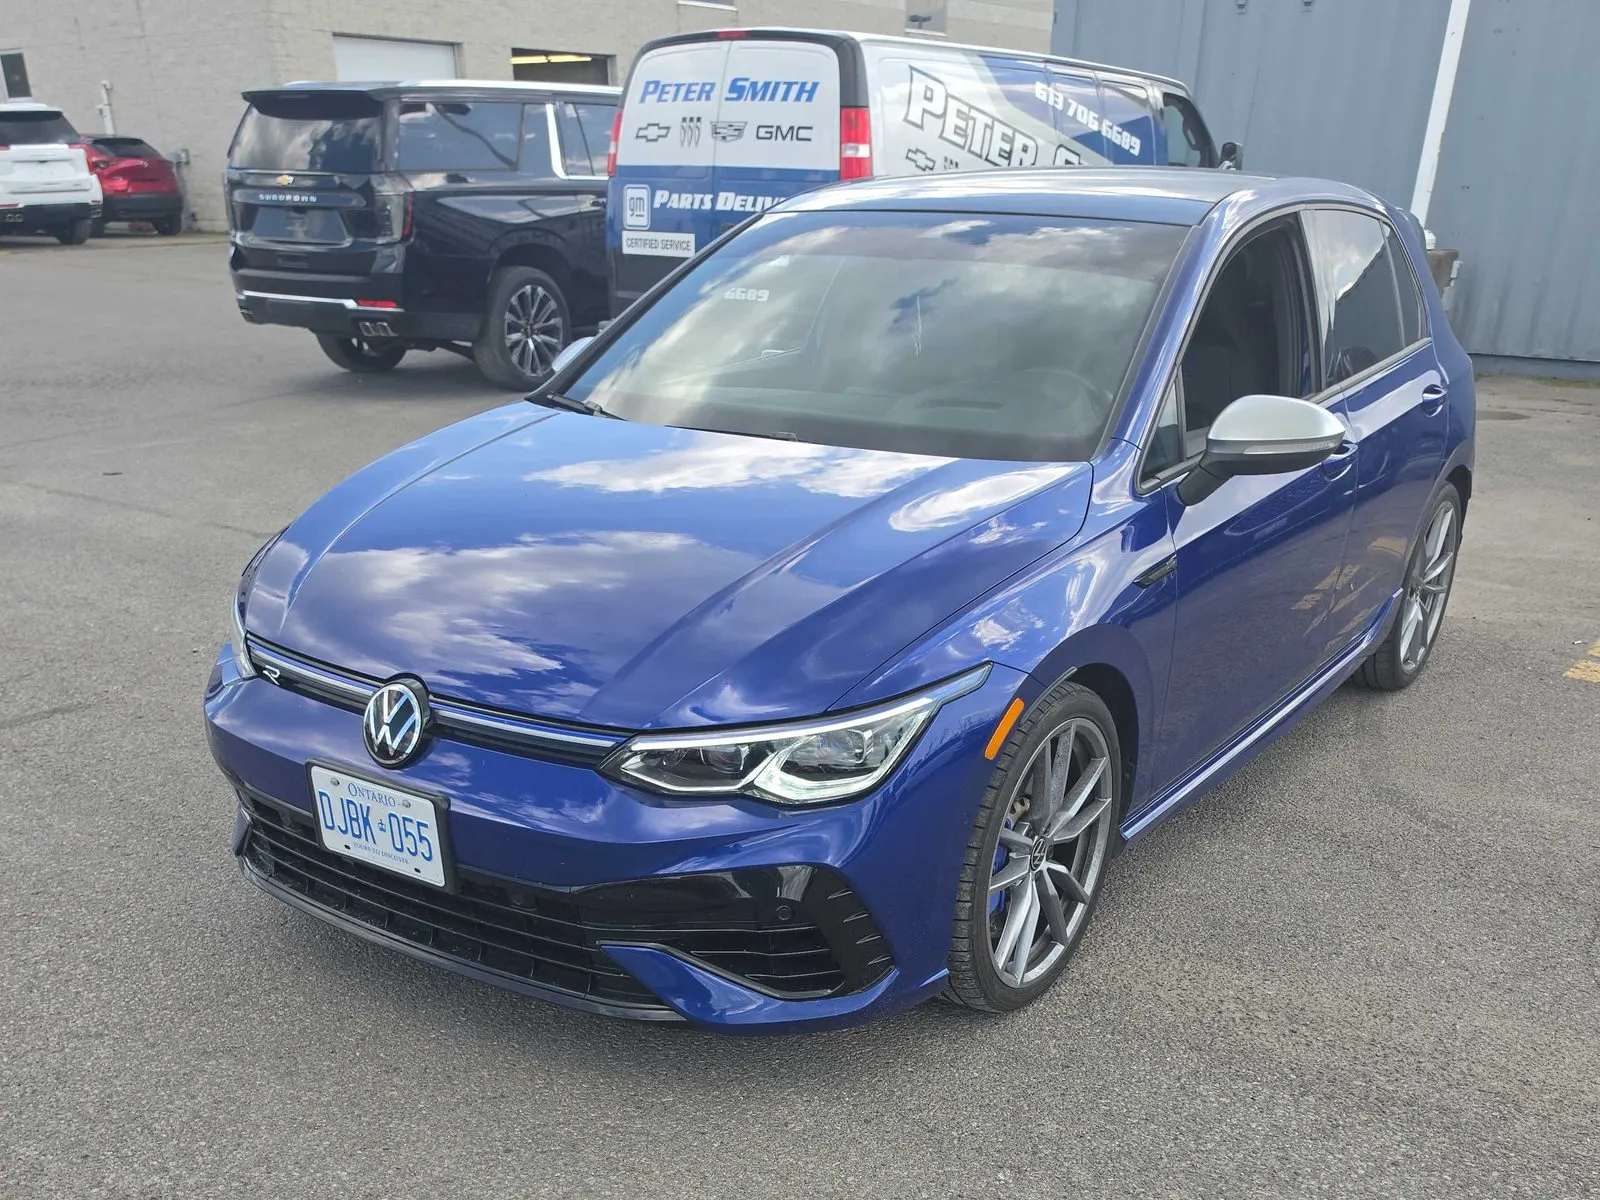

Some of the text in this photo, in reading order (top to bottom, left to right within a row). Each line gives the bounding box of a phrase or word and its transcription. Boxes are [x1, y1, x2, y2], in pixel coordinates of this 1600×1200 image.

[639, 77, 820, 104] PETER SMITH
[1035, 81, 1064, 111] 613
[1066, 98, 1099, 132] 706
[1101, 118, 1141, 157] 6689
[756, 125, 813, 142] GMC
[628, 196, 645, 218] gm
[653, 190, 787, 212] PARTS DELIV
[626, 237, 692, 252] CERTIFIED SERVICE
[347, 783, 395, 807] ONTARIO
[318, 791, 433, 862] DJBK 055
